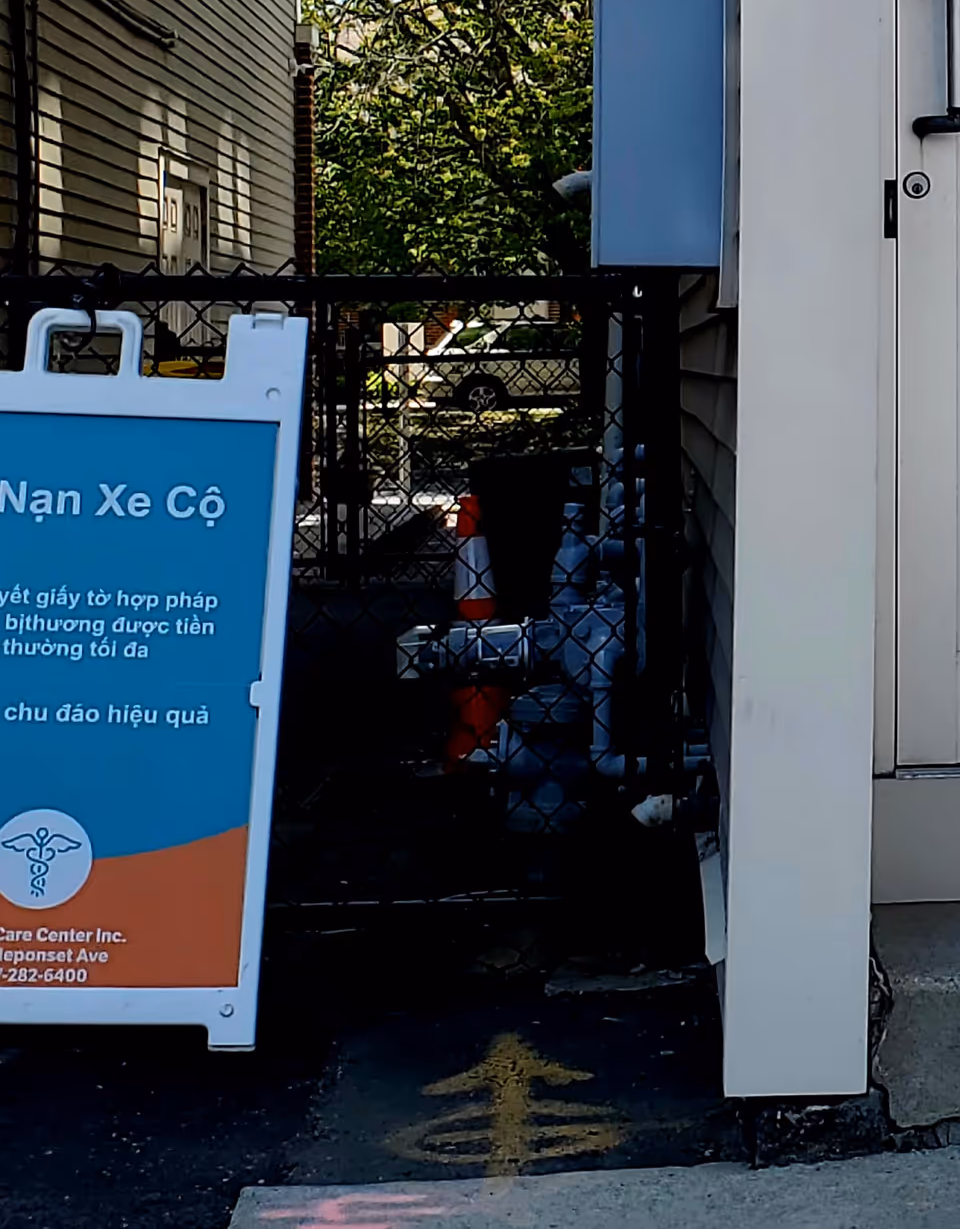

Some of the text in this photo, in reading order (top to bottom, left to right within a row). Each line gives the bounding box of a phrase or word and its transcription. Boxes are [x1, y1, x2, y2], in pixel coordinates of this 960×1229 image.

[0, 479, 226, 527] Nạn Xe Cộ
[36, 585, 80, 610] giấy
[87, 588, 112, 607] tờ
[117, 590, 160, 612] hợp
[166, 591, 219, 613] pháp
[112, 617, 171, 639] được
[176, 613, 216, 636] tiền
[3, 636, 149, 661] thường tối đa
[4, 702, 210, 729] chu đáo hiệu quả
[36, 926, 94, 943] Center
[96, 927, 128, 944] Inc.
[0, 947, 109, 966] eponset Ave
[0, 967, 88, 983] -282-6400
